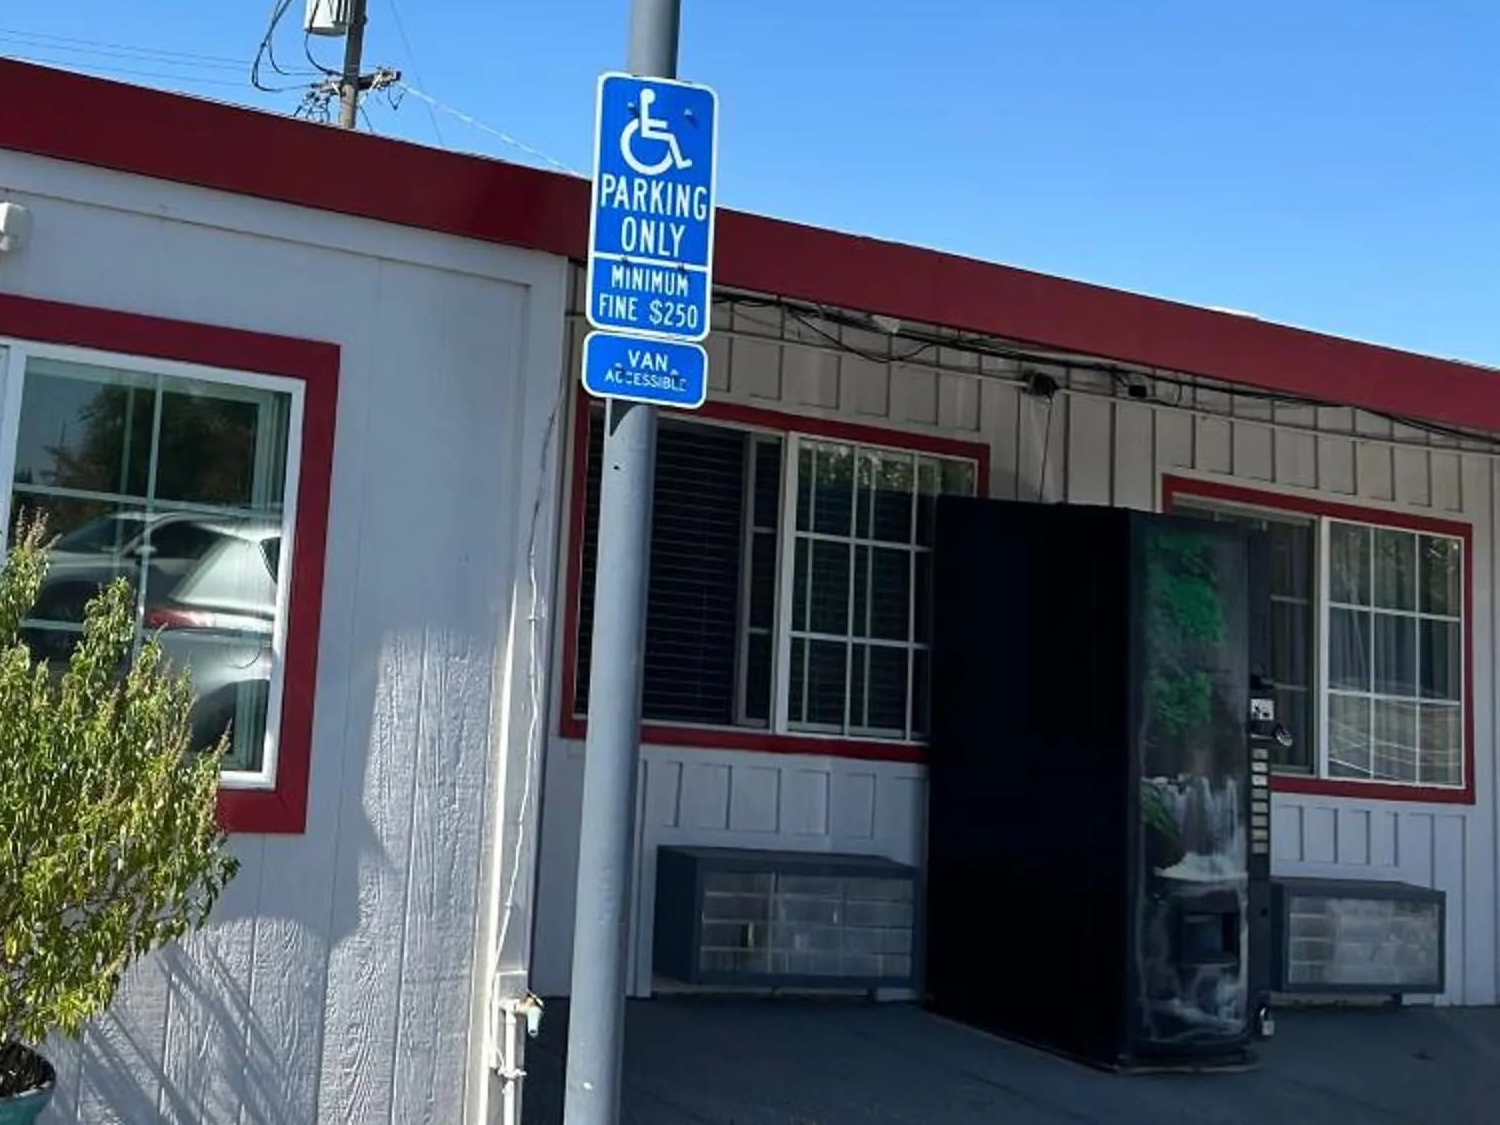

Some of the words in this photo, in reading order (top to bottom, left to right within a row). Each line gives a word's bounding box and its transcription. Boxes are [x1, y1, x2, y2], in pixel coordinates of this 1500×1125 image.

[600, 173, 708, 221] PARKING
[621, 216, 686, 258] ONLY
[611, 264, 689, 297] MINIMUM
[599, 293, 639, 322] FINE
[649, 299, 698, 329] $250
[627, 349, 668, 372] VAN
[604, 368, 688, 392] ACCESSIBLE
